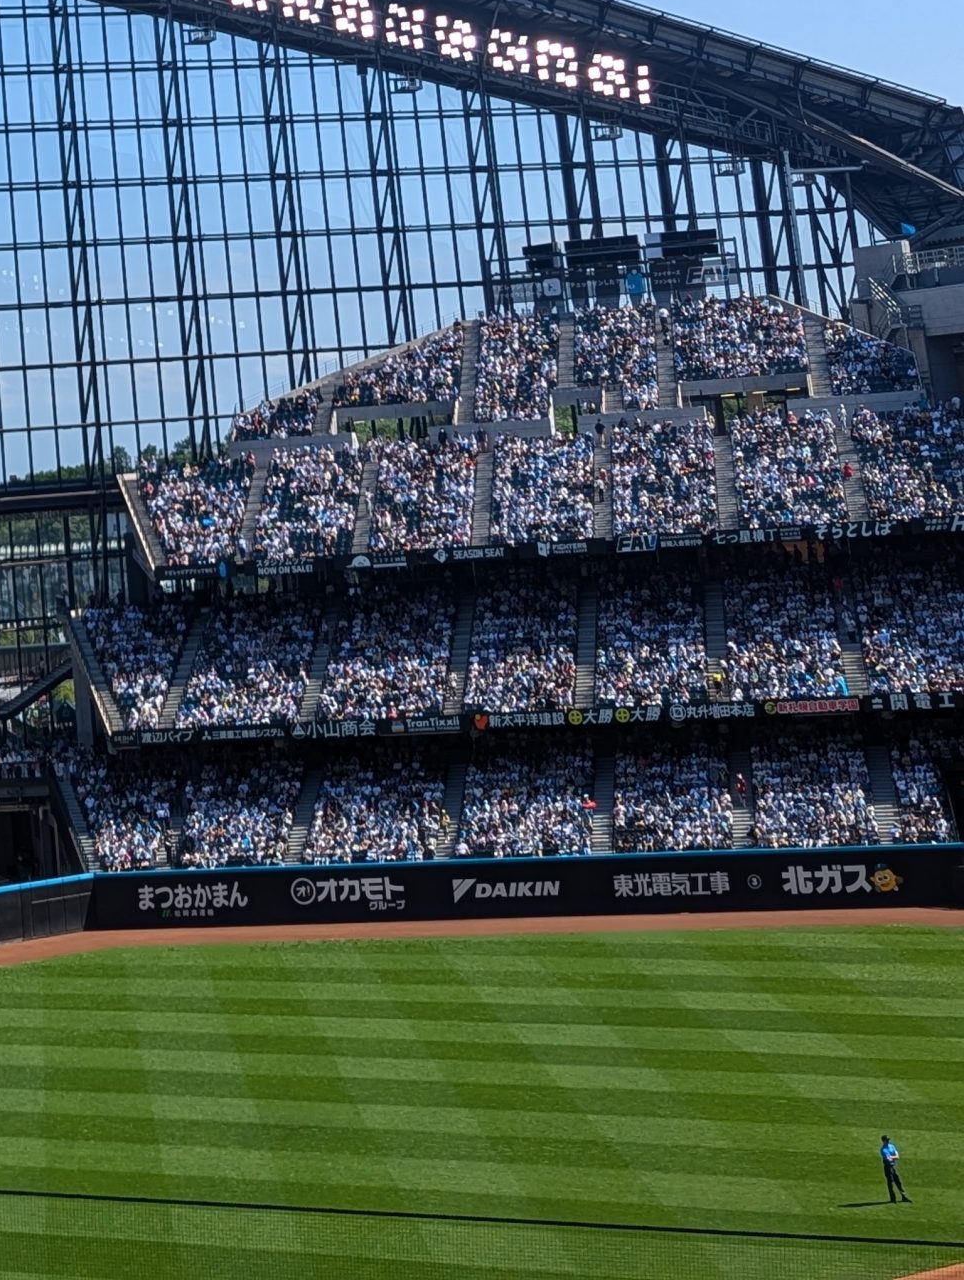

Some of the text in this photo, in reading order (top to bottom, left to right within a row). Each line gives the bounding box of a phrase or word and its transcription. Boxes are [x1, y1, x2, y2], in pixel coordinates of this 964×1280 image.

[713, 529, 777, 545] 七つ星横丁
[815, 521, 897, 540] そらとしば
[616, 534, 658, 553] FAV
[453, 549, 483, 560] SEASON
[485, 547, 505, 558] SEAT
[258, 567, 277, 575] NOW
[278, 566, 290, 574] ON
[889, 692, 956, 711] 関電工
[489, 712, 566, 728] 新太平洋建設
[583, 708, 613, 724] 大勝
[630, 706, 661, 721] 大勝
[306, 720, 376, 738] 小山商会
[613, 871, 730, 897] 東光電気工事
[781, 864, 873, 895] 北ガス
[138, 881, 248, 910] まつおかまん
[316, 876, 405, 902] オカモト
[475, 881, 560, 898] DAIKIN
[369, 899, 406, 910] グループ
